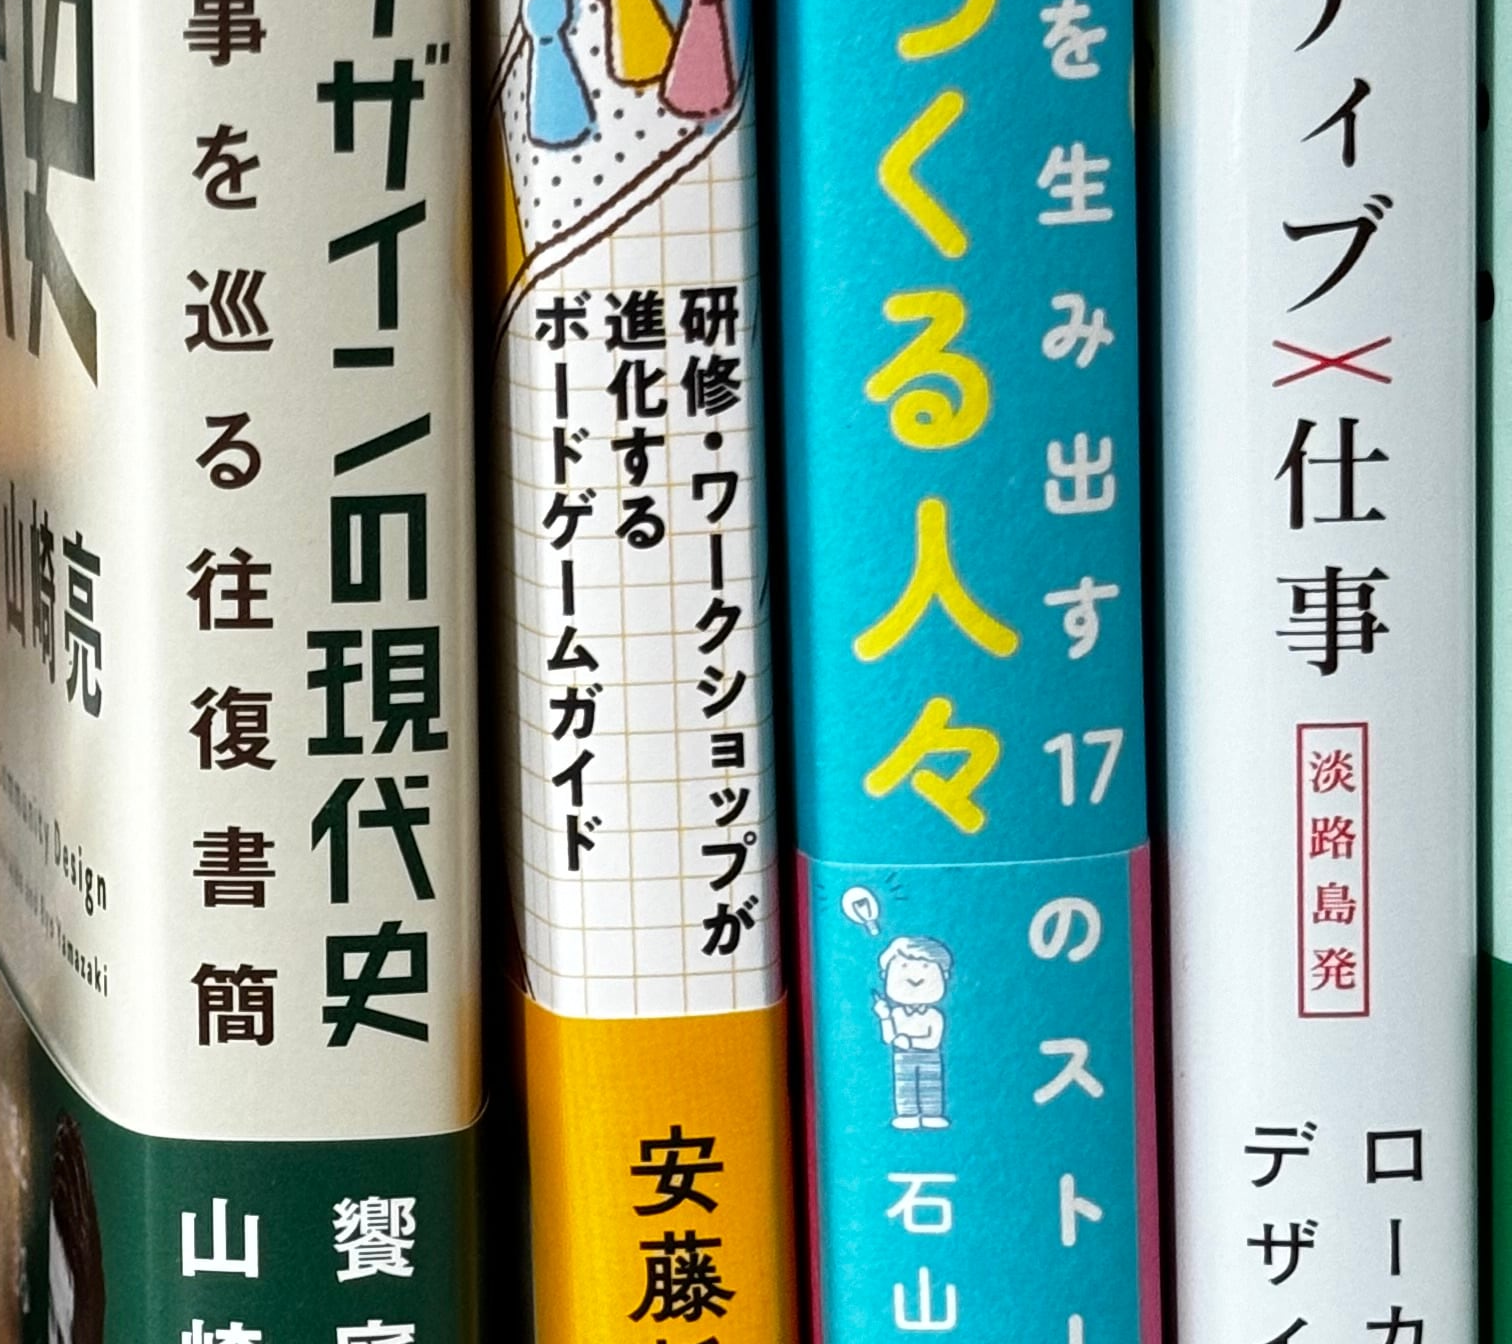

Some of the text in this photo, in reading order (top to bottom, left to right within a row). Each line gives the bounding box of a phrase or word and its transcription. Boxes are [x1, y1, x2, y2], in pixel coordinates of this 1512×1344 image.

[605, 289, 669, 549] 進化する
[534, 292, 603, 871] ボードゲームガイド
[679, 284, 758, 957] 研修・ワークショップが
[53, 816, 108, 916] Design
[55, 914, 109, 997] Yamazaki
[1309, 749, 1357, 990] 淡路島発
